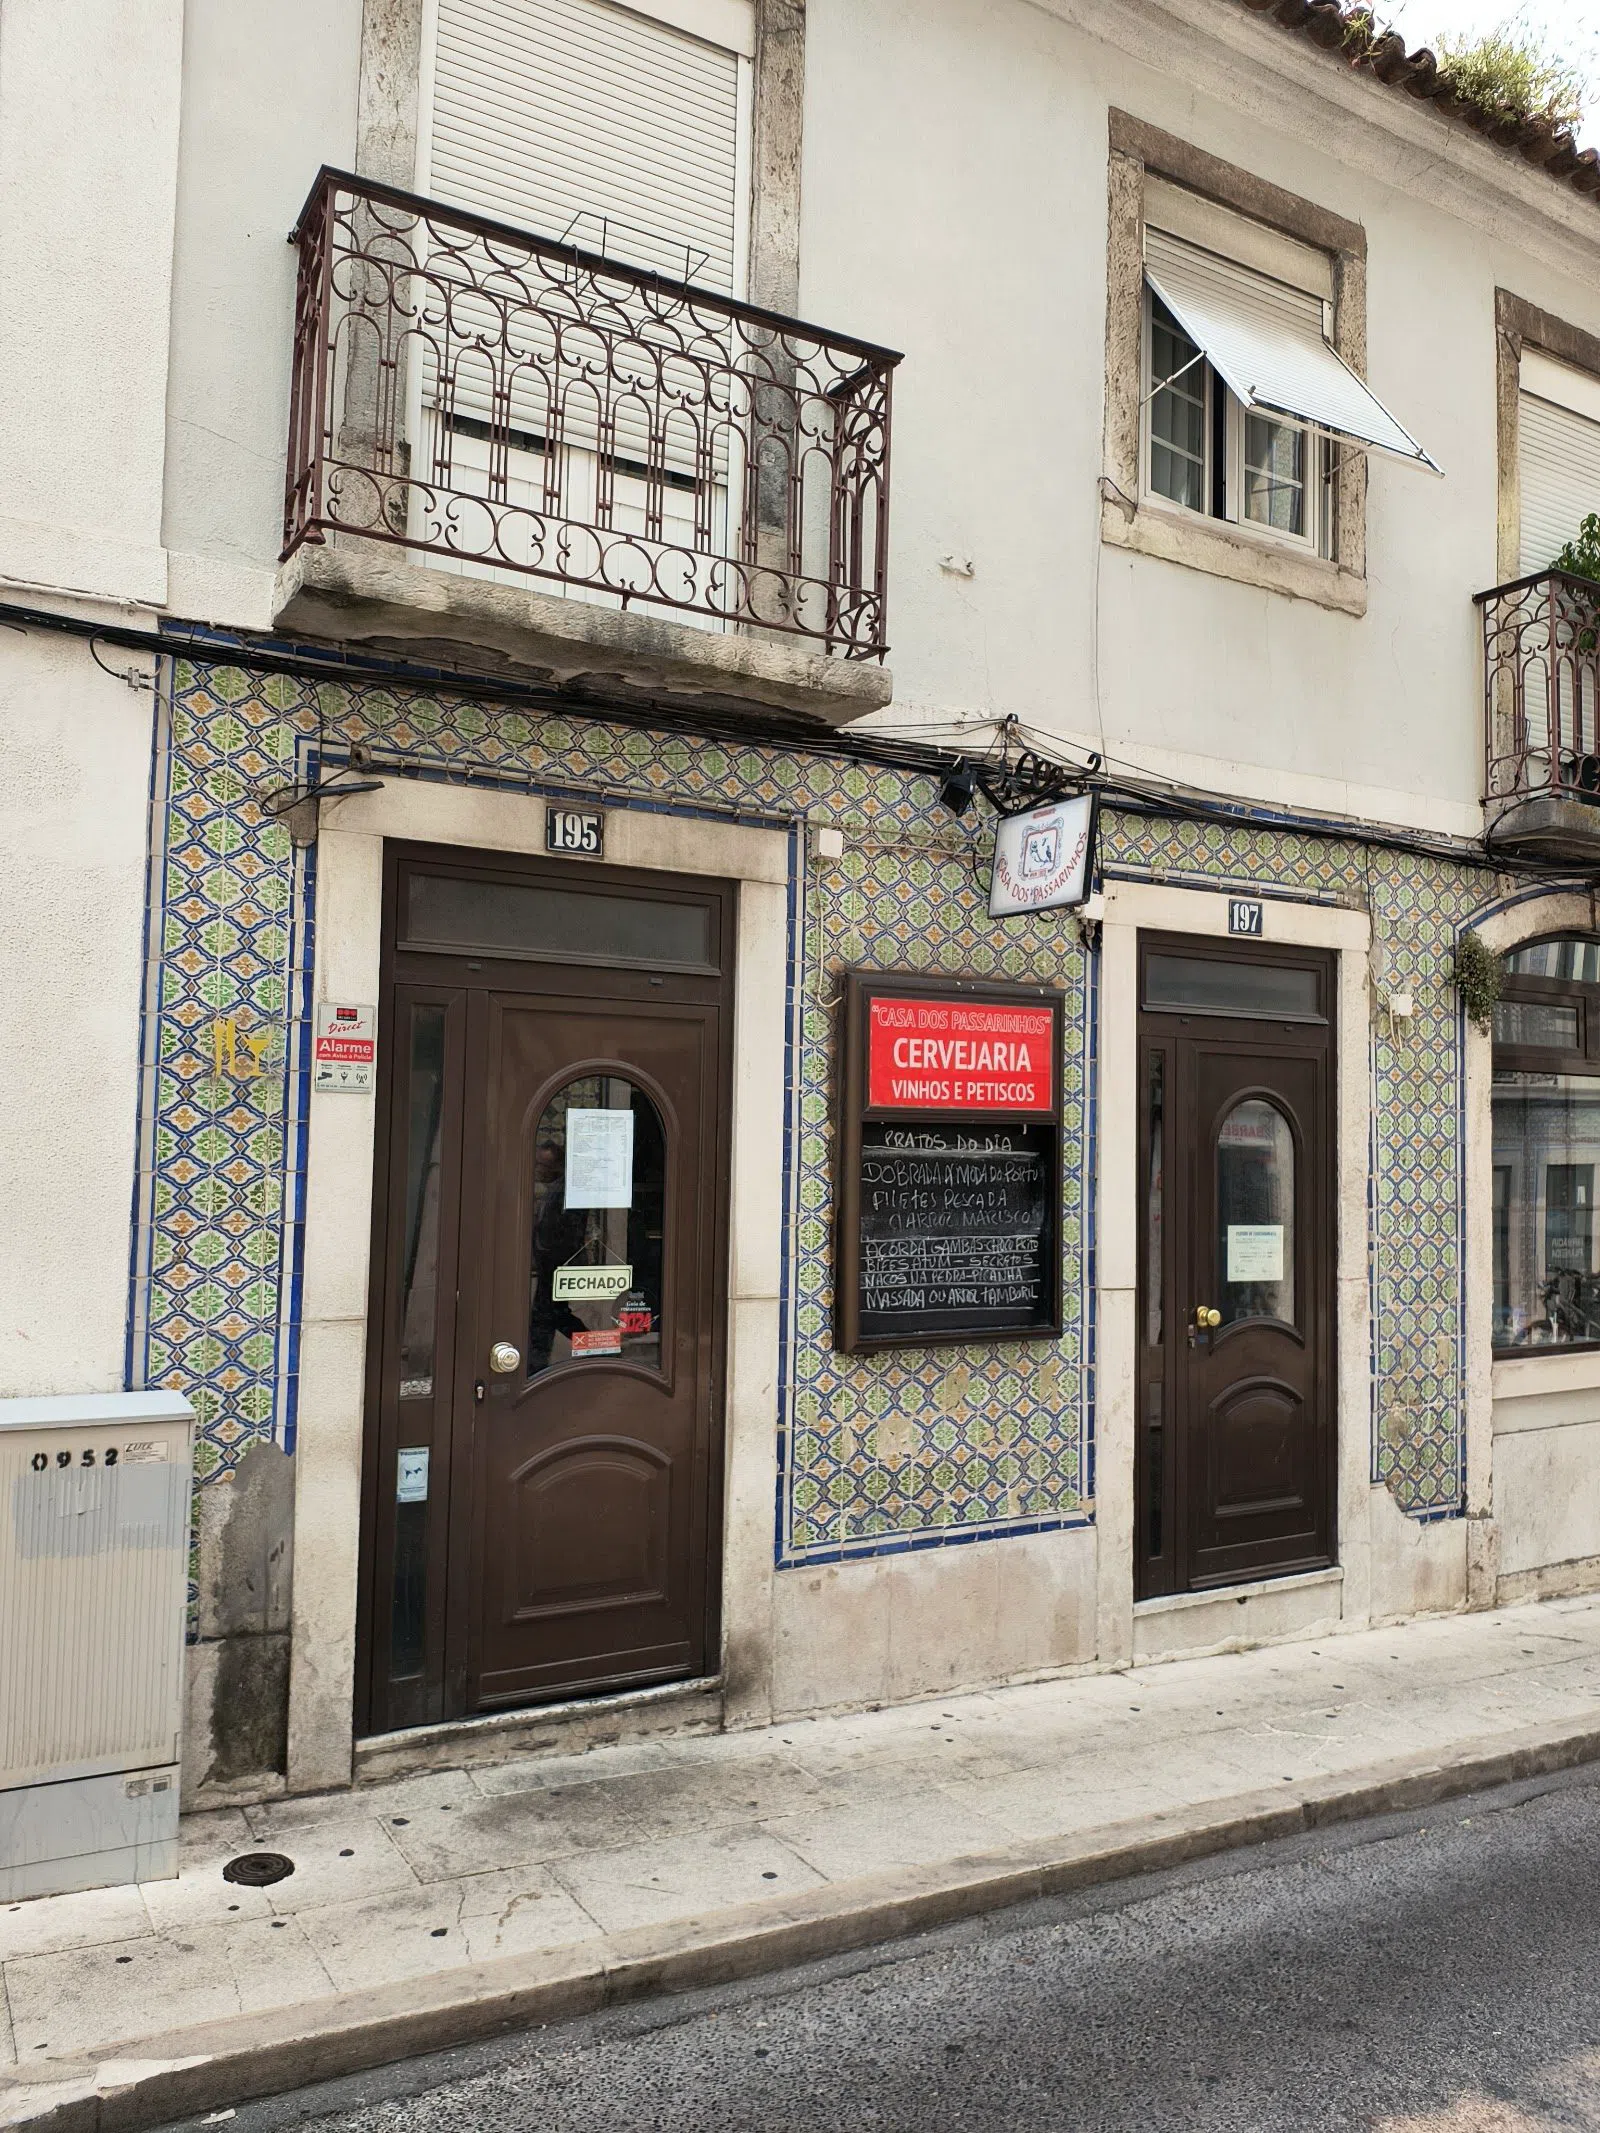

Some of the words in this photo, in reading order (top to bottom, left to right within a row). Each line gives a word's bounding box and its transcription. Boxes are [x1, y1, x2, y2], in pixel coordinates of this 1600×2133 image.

[553, 812, 598, 851] 195
[996, 857, 1012, 891] CASA
[1011, 884, 1029, 902] DOS
[1034, 832, 1087, 902] PASSARINHOS
[1232, 903, 1259, 932] 197
[328, 1020, 367, 1035] Direct
[918, 1009, 948, 1029] DOS
[319, 1039, 371, 1054] Alarme
[893, 1037, 1032, 1072] CERVEJARIA
[892, 1079, 950, 1101] VINHOS
[954, 1082, 963, 1100] E
[967, 1082, 1035, 1102] PETISCOS
[885, 1130, 947, 1151] PRATOS
[956, 1134, 978, 1151] DO
[861, 1159, 942, 1187] DOBRADA
[956, 1163, 988, 1187] MODA
[989, 1165, 1002, 1182] DO
[943, 1188, 1008, 1210] PESCADA
[962, 1209, 1031, 1227] MARISCO
[865, 1256, 910, 1272] BIFES
[912, 1255, 951, 1270] ATUM
[969, 1253, 1034, 1268] SECRETOS
[559, 1276, 628, 1290] FECHADO
[864, 1272, 908, 1288] NACOS
[910, 1269, 928, 1285] NA
[866, 1288, 925, 1309] MASSADA
[928, 1289, 947, 1304] OU
[618, 1312, 652, 1332] 2024
[31, 1447, 119, 1472] 0952
